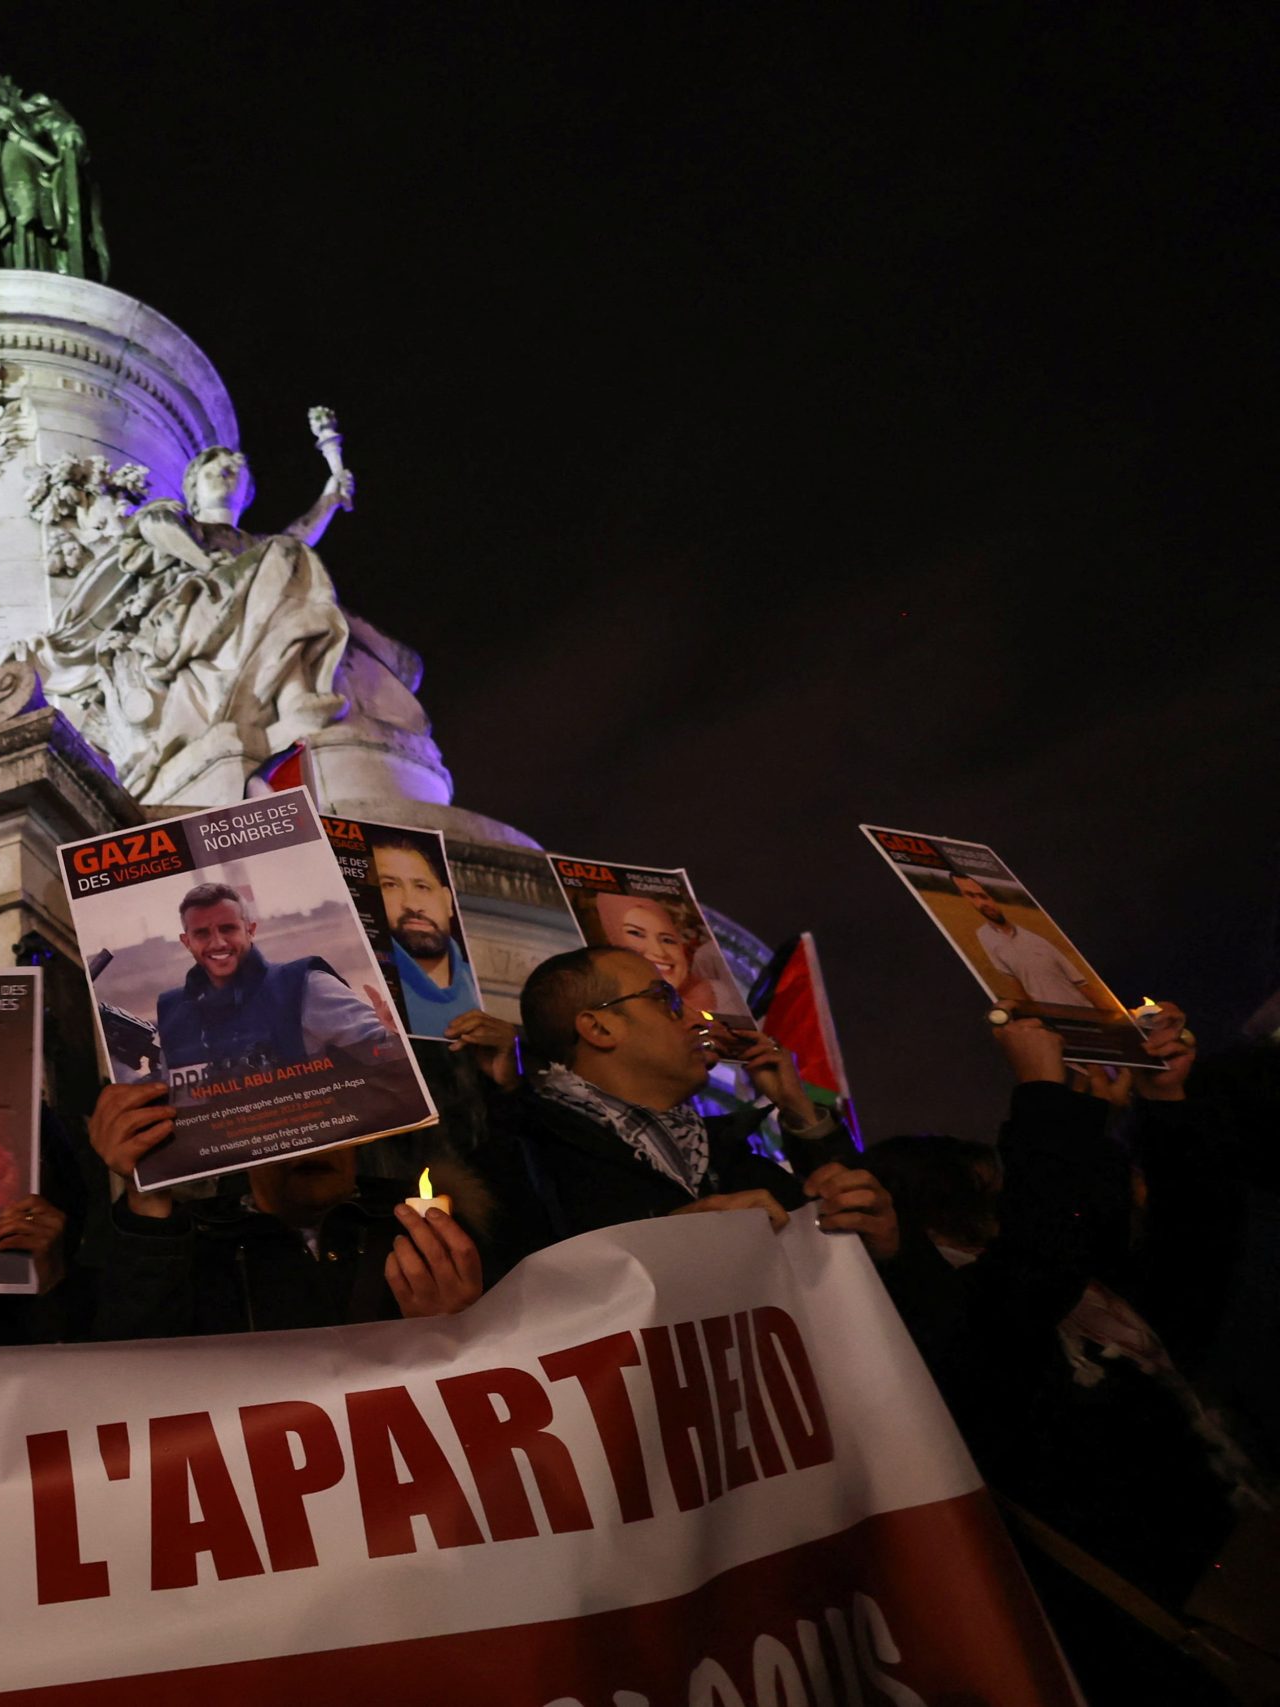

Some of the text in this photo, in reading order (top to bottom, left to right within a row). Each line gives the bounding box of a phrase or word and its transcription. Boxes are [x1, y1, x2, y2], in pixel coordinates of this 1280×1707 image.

[199, 802, 299, 837] PAS QUE DES
[204, 818, 296, 853] NOMBRES
[73, 829, 178, 875] GAZA
[350, 857, 369, 869] DES
[77, 855, 183, 893] DES VISAGES
[557, 861, 617, 884] GAZA
[0, 984, 28, 997] DES
[190, 1057, 335, 1100] KHALIL ABU AATHRA
[174, 1112, 211, 1128] Reporter
[211, 1110, 221, 1119] et
[220, 1098, 273, 1120] photographe
[272, 1094, 294, 1106] dans
[294, 1092, 302, 1101] le
[302, 1085, 332, 1102] groupe
[332, 1077, 366, 1093] Al-Aqsa
[199, 1146, 211, 1157] de
[211, 1145, 220, 1155] la
[220, 1138, 250, 1153] maison
[251, 1136, 262, 1145] de
[263, 1132, 279, 1142] son
[279, 1126, 300, 1140] frère
[300, 1122, 320, 1137] près
[320, 1118, 331, 1130] de
[251, 1147, 263, 1157] au
[263, 1141, 280, 1153] sud
[280, 1139, 291, 1150] de
[26, 1304, 835, 1606] L'APARTHEID
